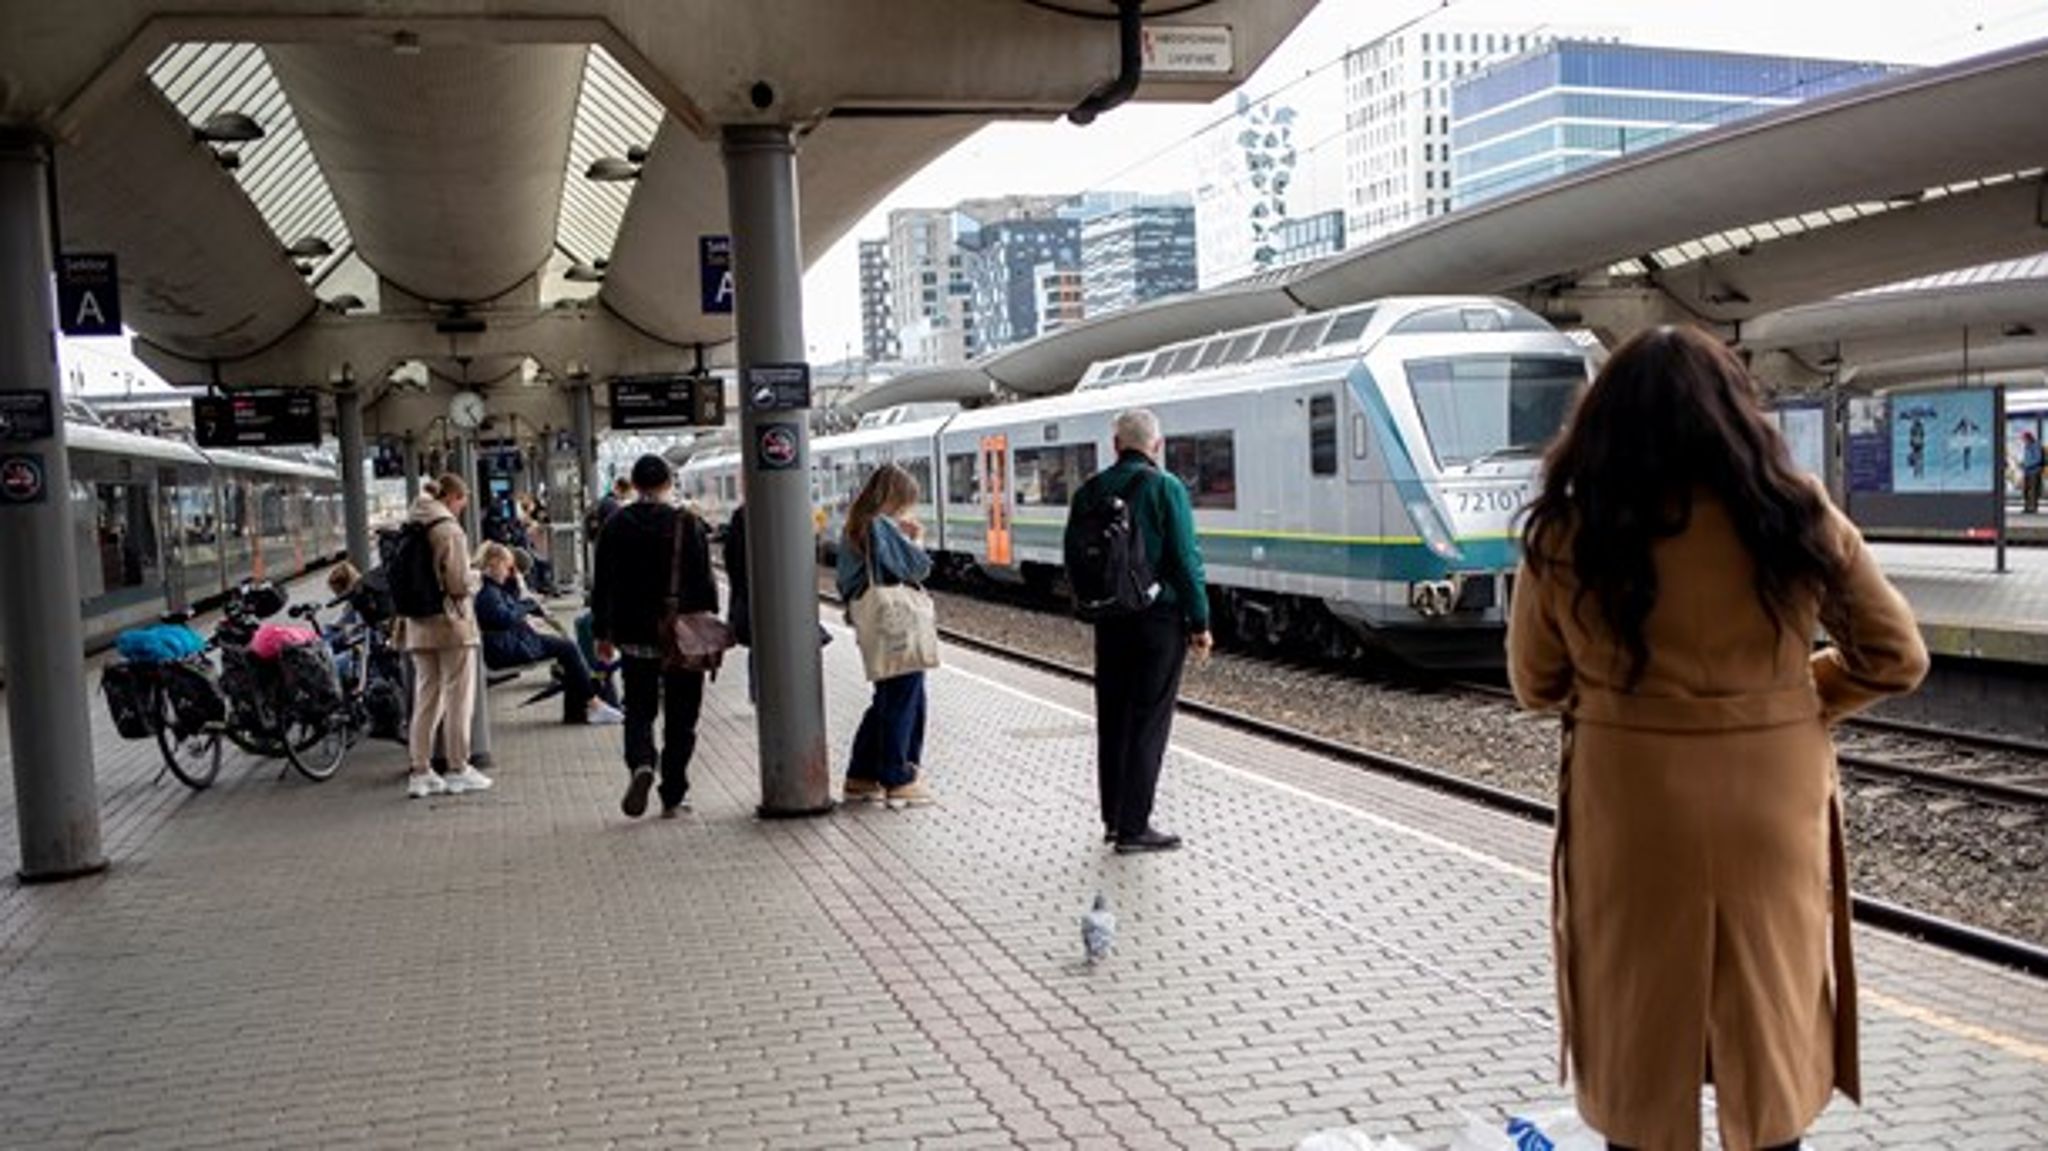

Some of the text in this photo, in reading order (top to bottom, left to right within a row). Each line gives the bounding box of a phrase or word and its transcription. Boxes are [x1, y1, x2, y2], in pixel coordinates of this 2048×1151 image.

[714, 270, 735, 303] A
[76, 290, 106, 325] A
[1457, 490, 1521, 513] 72101
